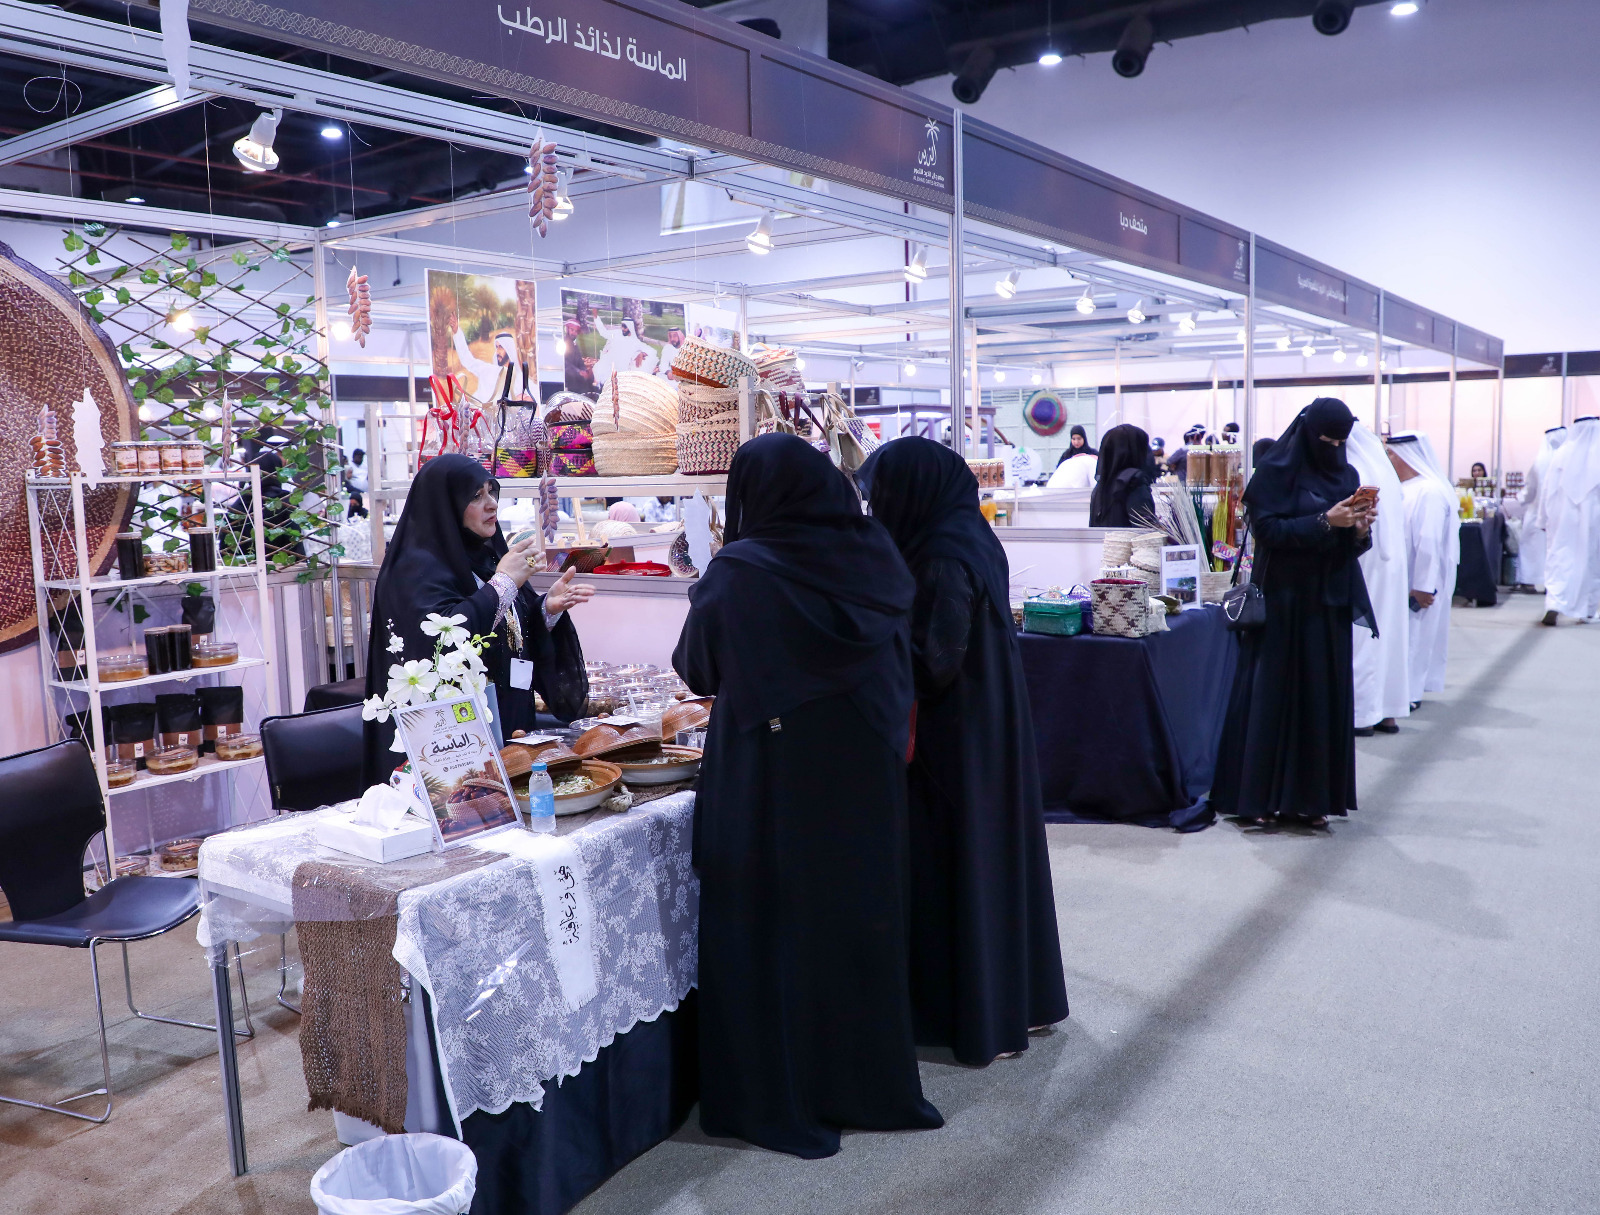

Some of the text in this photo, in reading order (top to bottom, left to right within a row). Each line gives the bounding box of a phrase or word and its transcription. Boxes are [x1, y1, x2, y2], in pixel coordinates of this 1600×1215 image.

[497, 4, 687, 82] الماسة لذائذ الرطب
[1120, 211, 1148, 235] متحف دبا
[432, 732, 470, 754] الماسة
